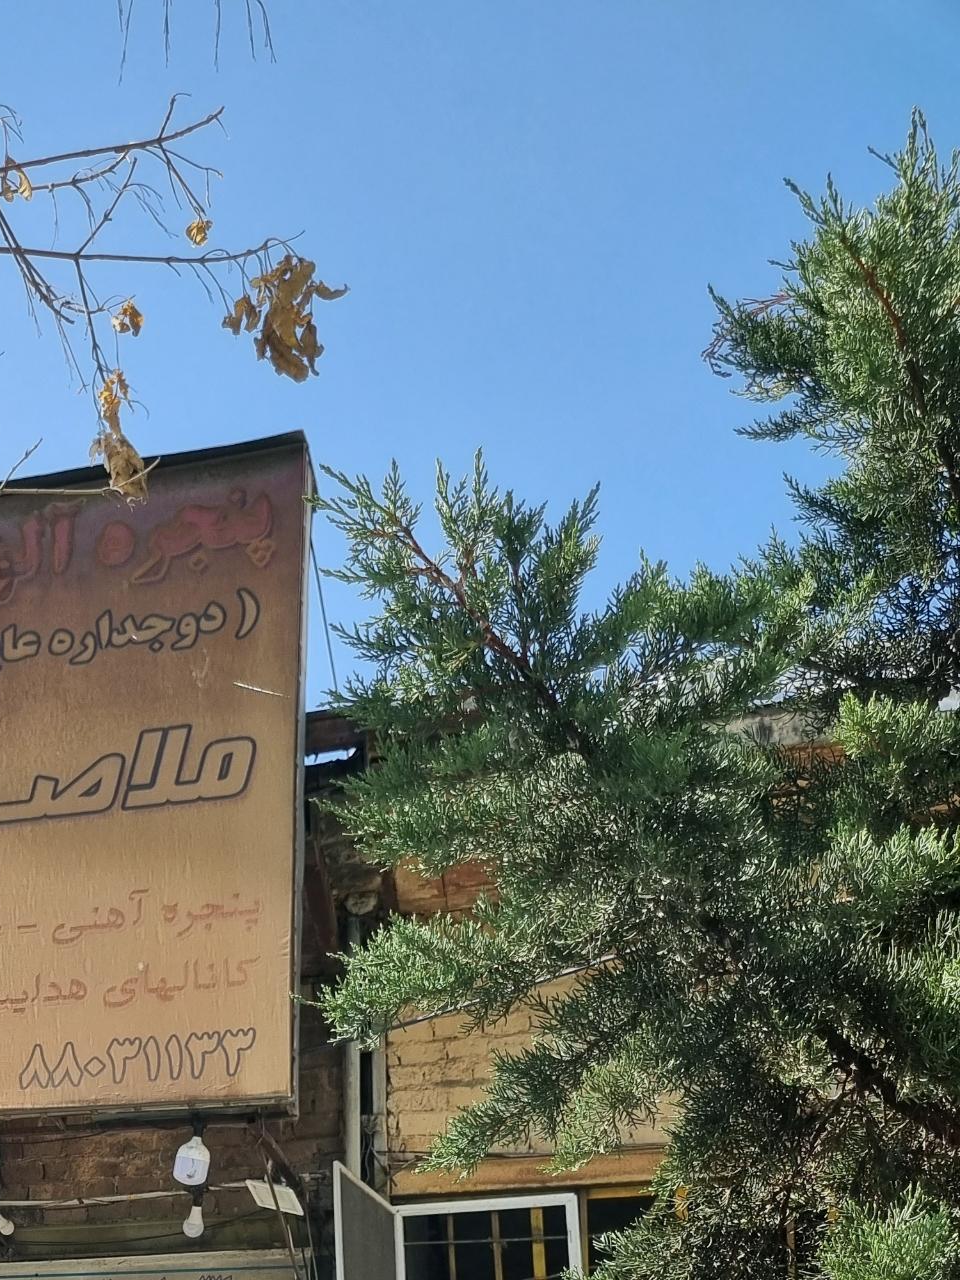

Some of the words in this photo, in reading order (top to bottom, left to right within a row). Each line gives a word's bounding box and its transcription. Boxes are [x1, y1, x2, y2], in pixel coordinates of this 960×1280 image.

[51, 888, 150, 946] آهنی
[162, 893, 265, 938] پنجره
[19, 1027, 257, 1090] ۸۸۰۳۱۱۳۳
